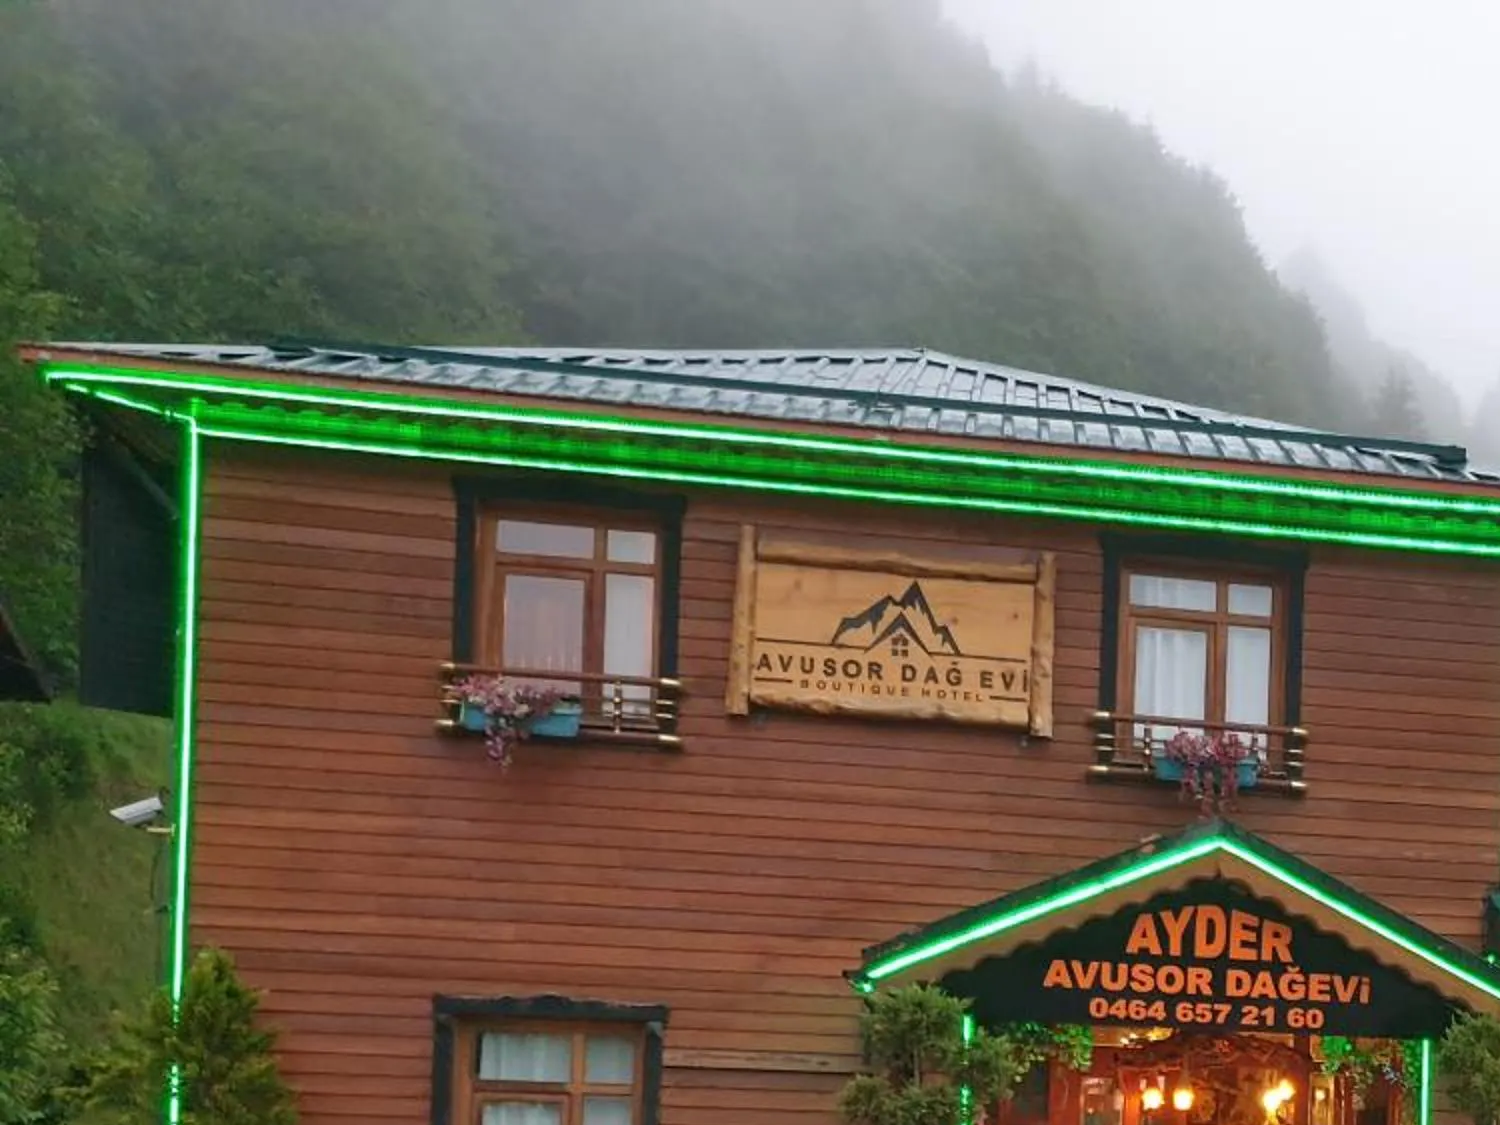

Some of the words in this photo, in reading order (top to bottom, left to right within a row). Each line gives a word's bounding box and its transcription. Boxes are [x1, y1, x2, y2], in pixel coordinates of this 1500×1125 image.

[756, 653, 883, 680] AVUSOR
[901, 662, 962, 687] DAĞ
[800, 679, 909, 697] BOUTIQUE
[922, 687, 983, 702] HOTEL
[1125, 904, 1293, 963] AYDER
[1043, 959, 1213, 995] AVUSOR
[1089, 997, 1167, 1022] 0464
[1175, 1002, 1231, 1025] 657
[1240, 1005, 1275, 1027] 21
[1287, 1007, 1324, 1029] 60
